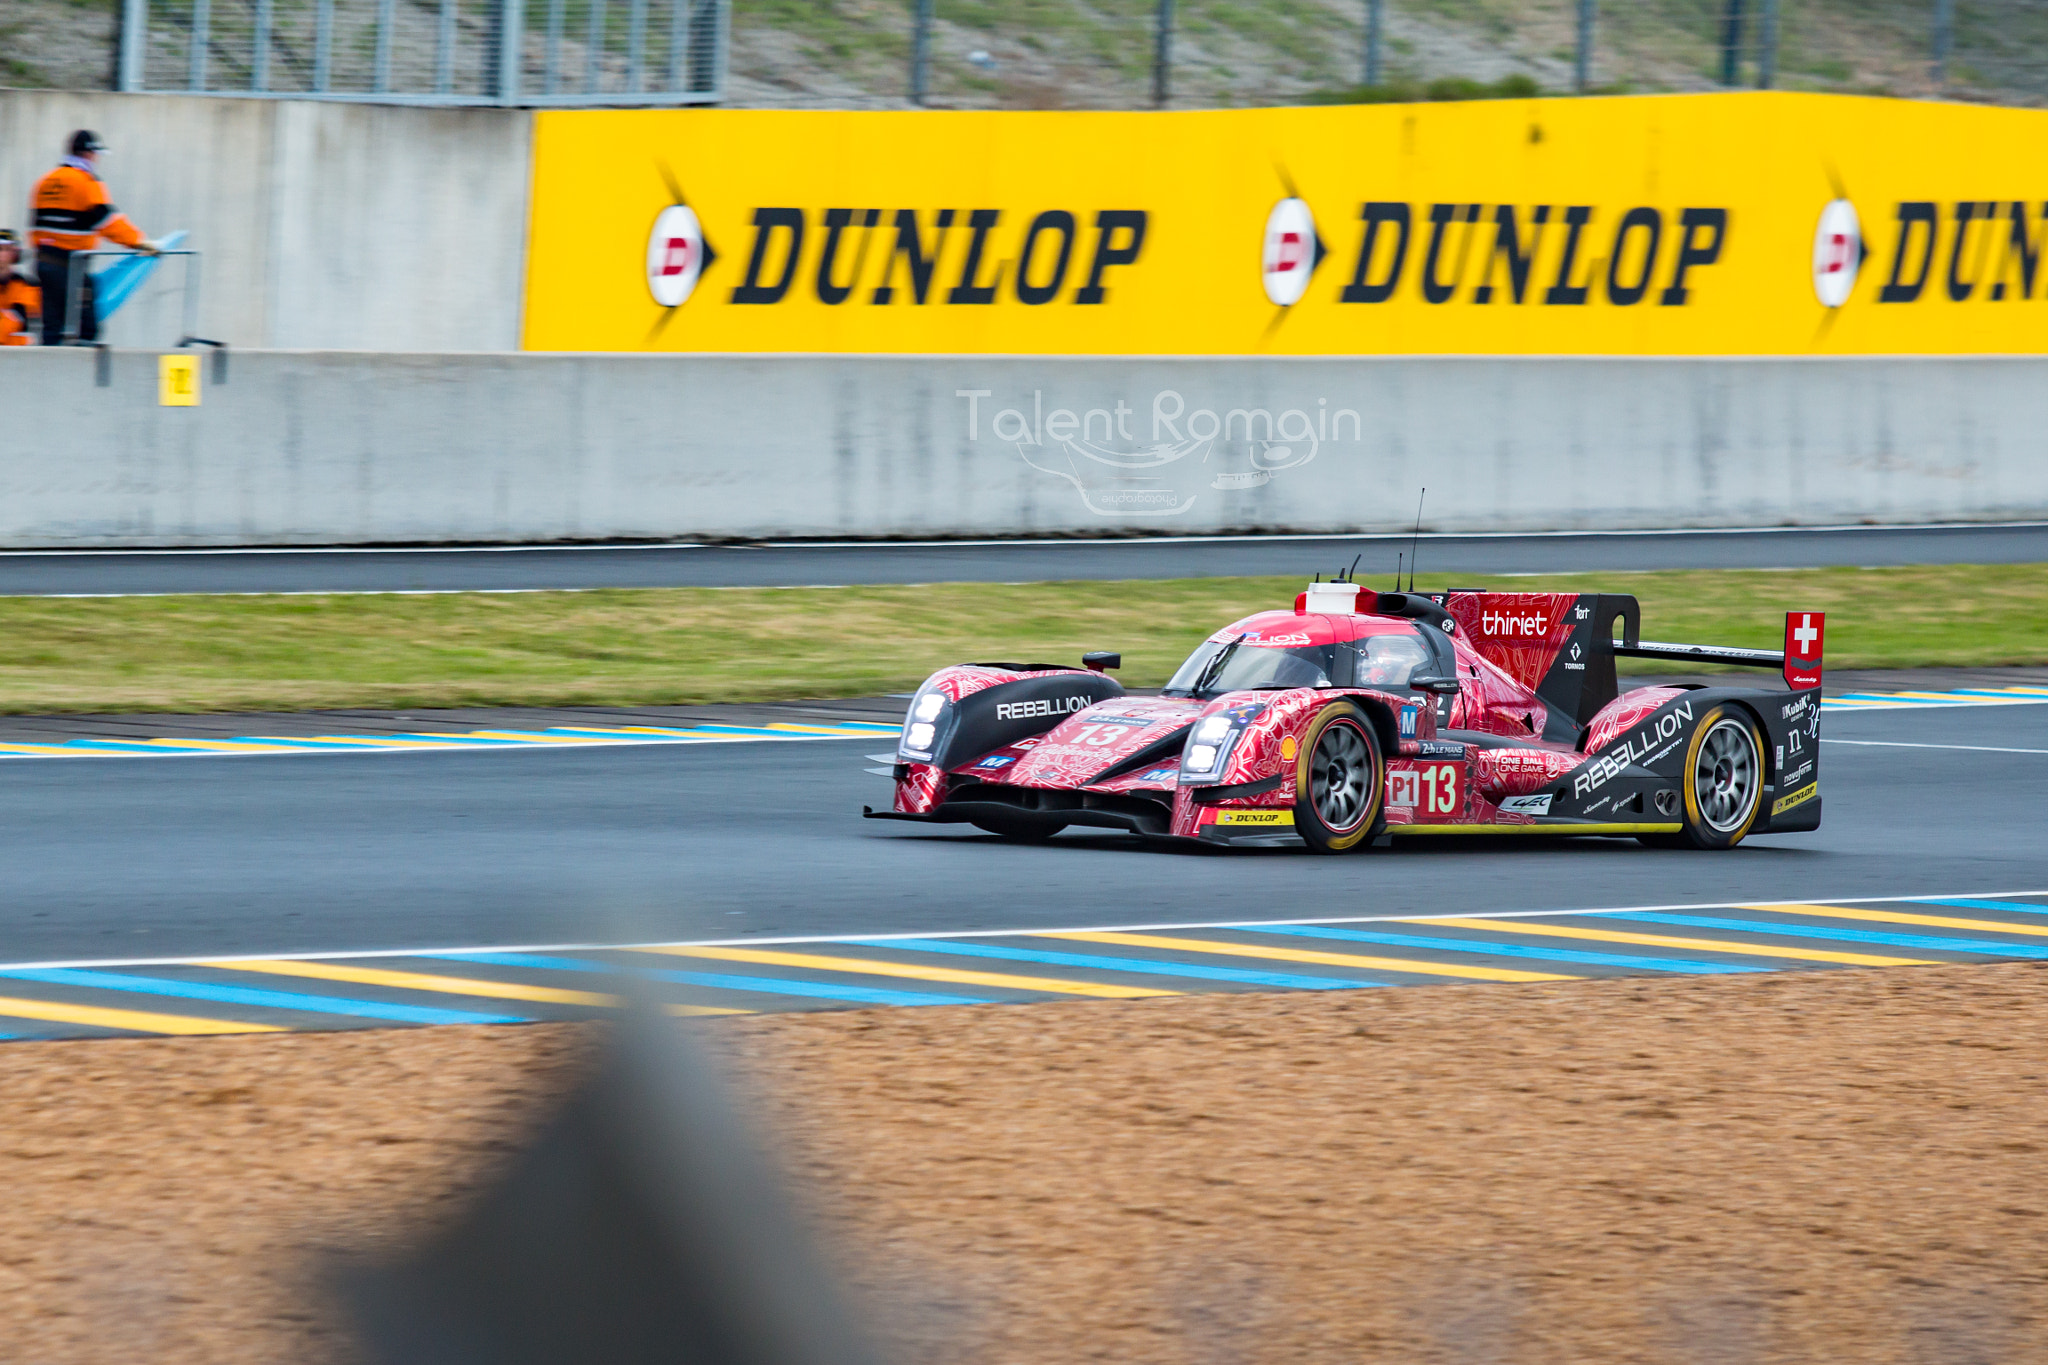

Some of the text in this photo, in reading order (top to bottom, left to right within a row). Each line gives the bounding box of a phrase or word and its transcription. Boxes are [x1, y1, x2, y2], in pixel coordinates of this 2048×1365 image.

[730, 206, 1150, 306] DUNLOP
[1338, 201, 1729, 306] DUNLOP
[1482, 610, 1547, 635] thiriet
[996, 695, 1092, 720] REBELLION
[1402, 711, 1416, 734] M
[1071, 724, 1129, 746] 13
[1574, 700, 1693, 800] REBELLION
[980, 757, 1010, 767] M
[1500, 764, 1519, 772] ONE
[1143, 771, 1173, 781] M
[1392, 776, 1414, 802] P1
[1422, 765, 1456, 813] 13
[1785, 785, 1815, 806] DUNLOP
[1512, 796, 1551, 807] WEC
[1235, 814, 1279, 822] DUNLOP
